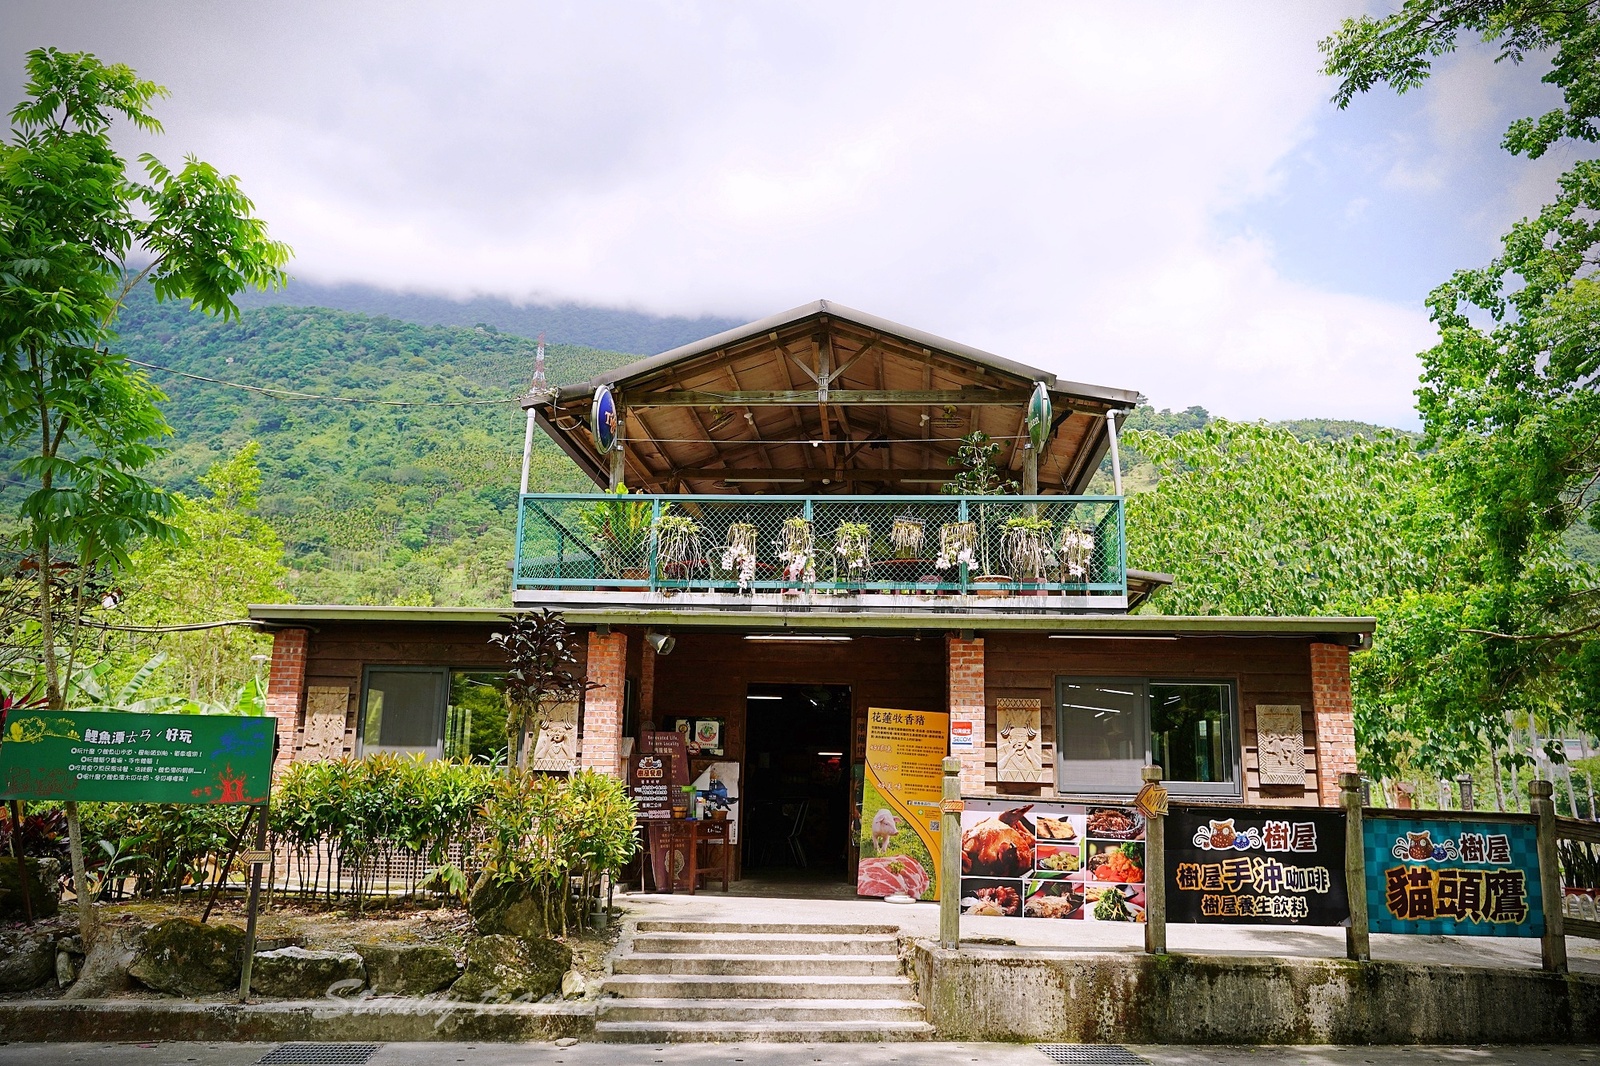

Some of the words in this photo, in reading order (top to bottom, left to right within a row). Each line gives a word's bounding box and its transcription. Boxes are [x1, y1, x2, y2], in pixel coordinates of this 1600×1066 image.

[870, 711, 926, 727] 花蓮牧香豬
[1262, 820, 1318, 853] 樹屋
[1458, 832, 1513, 865] 樹屋
[1176, 856, 1331, 894] 樹屋手沖咖啡
[1202, 897, 1309, 919] 樹屋養生飲料
[1385, 865, 1530, 925] 貓頭鷹
